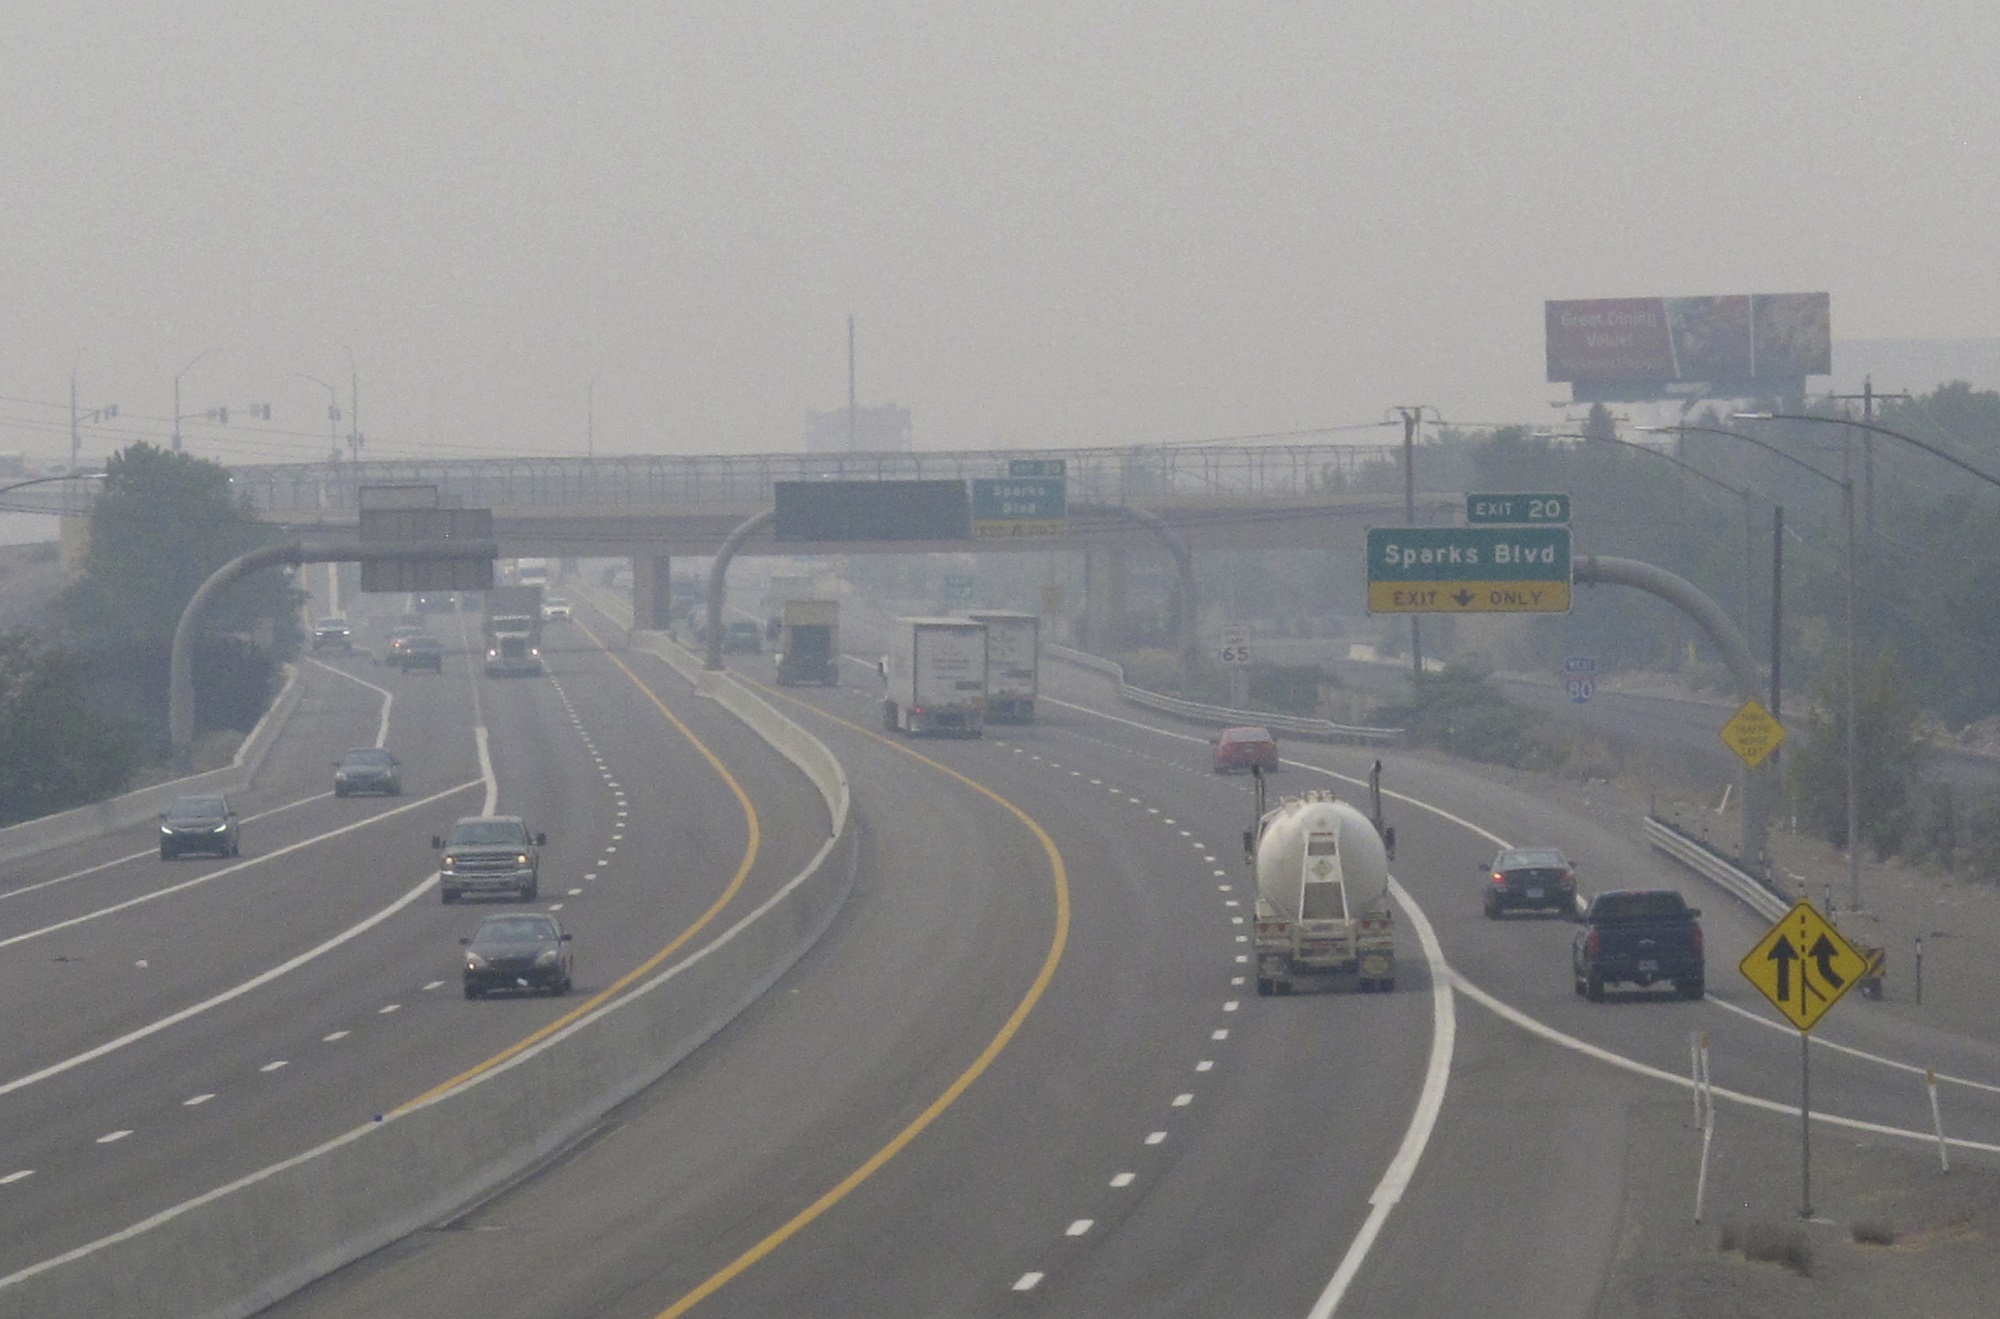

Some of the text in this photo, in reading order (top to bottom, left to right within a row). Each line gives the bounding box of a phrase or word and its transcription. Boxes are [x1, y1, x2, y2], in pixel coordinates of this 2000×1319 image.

[993, 486, 1045, 498] Sparks
[1003, 503, 1036, 514] Blvd
[1476, 499, 1560, 518] EXIT 20
[1385, 544, 1554, 569] Sparks Blvd
[1393, 591, 1543, 606] EXIT ONLY
[1222, 646, 1249, 662] 65
[1568, 681, 1593, 699] 80
